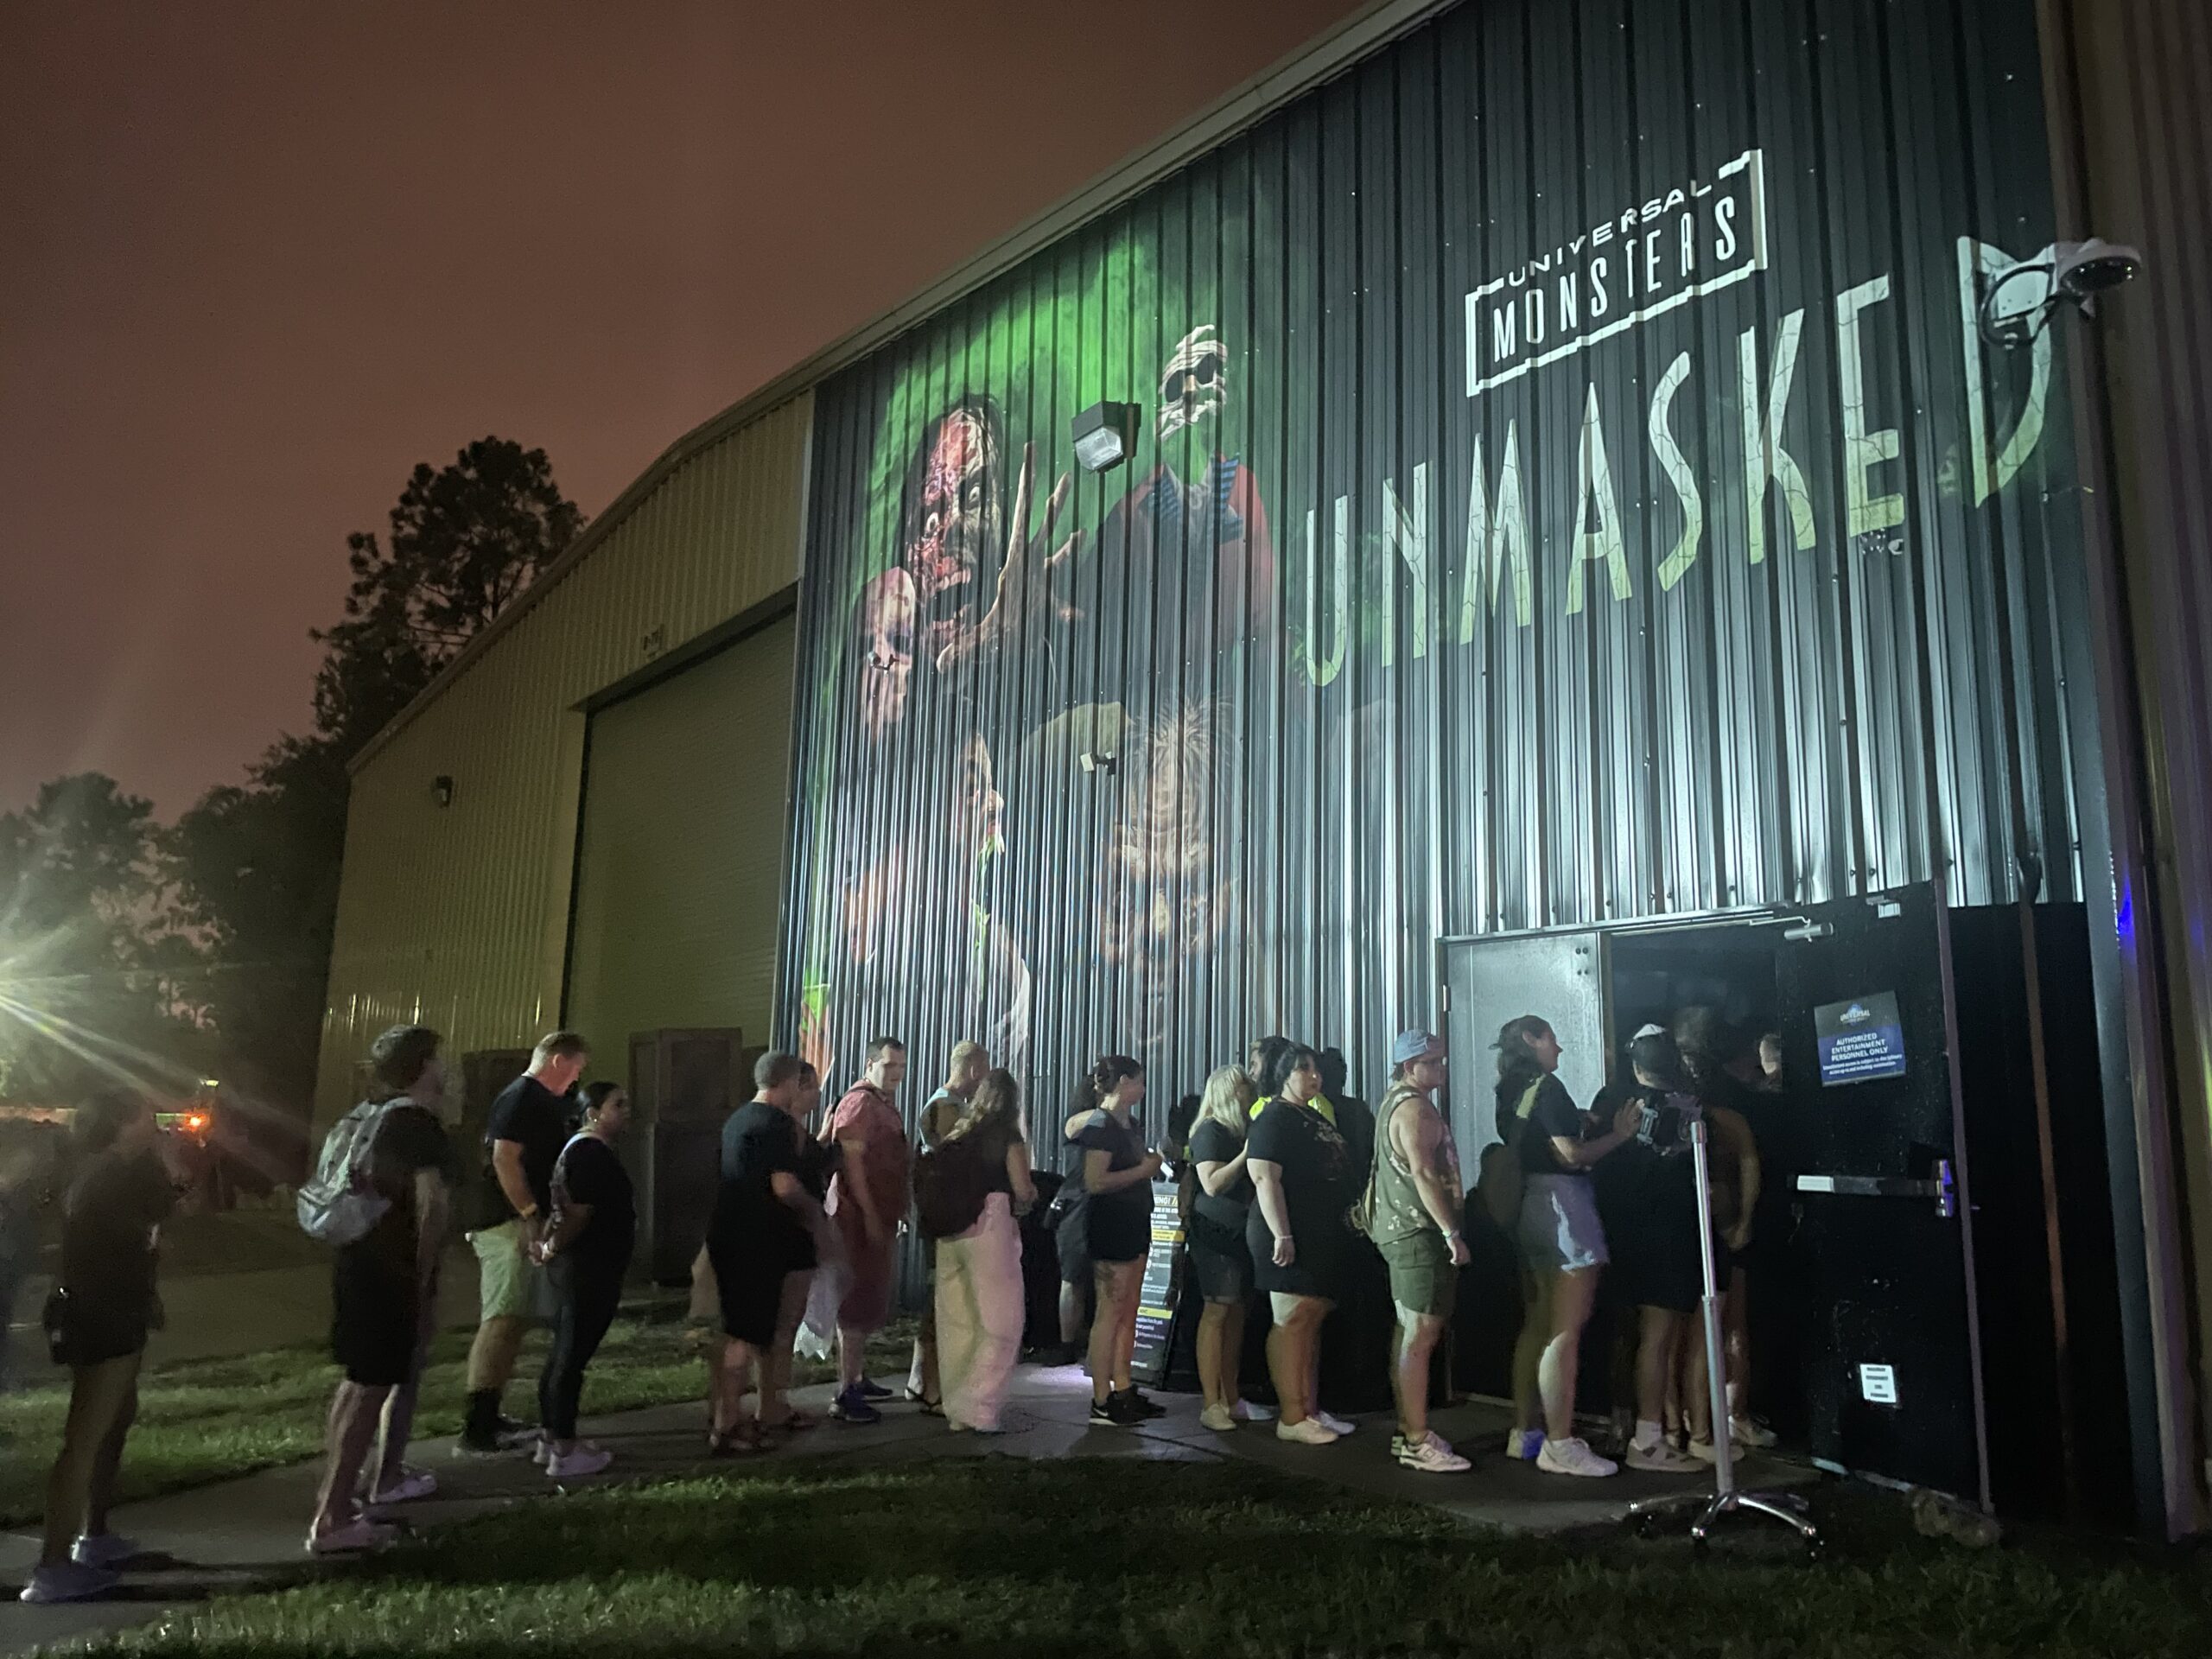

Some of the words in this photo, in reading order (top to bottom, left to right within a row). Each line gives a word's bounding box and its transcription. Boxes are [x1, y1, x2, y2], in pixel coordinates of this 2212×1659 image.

[1509, 180, 1712, 287] UNIVERSAL
[1493, 195, 1736, 363] MONSTERS
[1305, 235, 2053, 688] UNMASKED
[1831, 1039, 1885, 1054] ENTERTAINMENT
[1831, 1049, 1869, 1062] PERSONNEL
[1869, 1046, 1888, 1055] ONLY
[1836, 1033, 1877, 1046] AUTHORIZED
